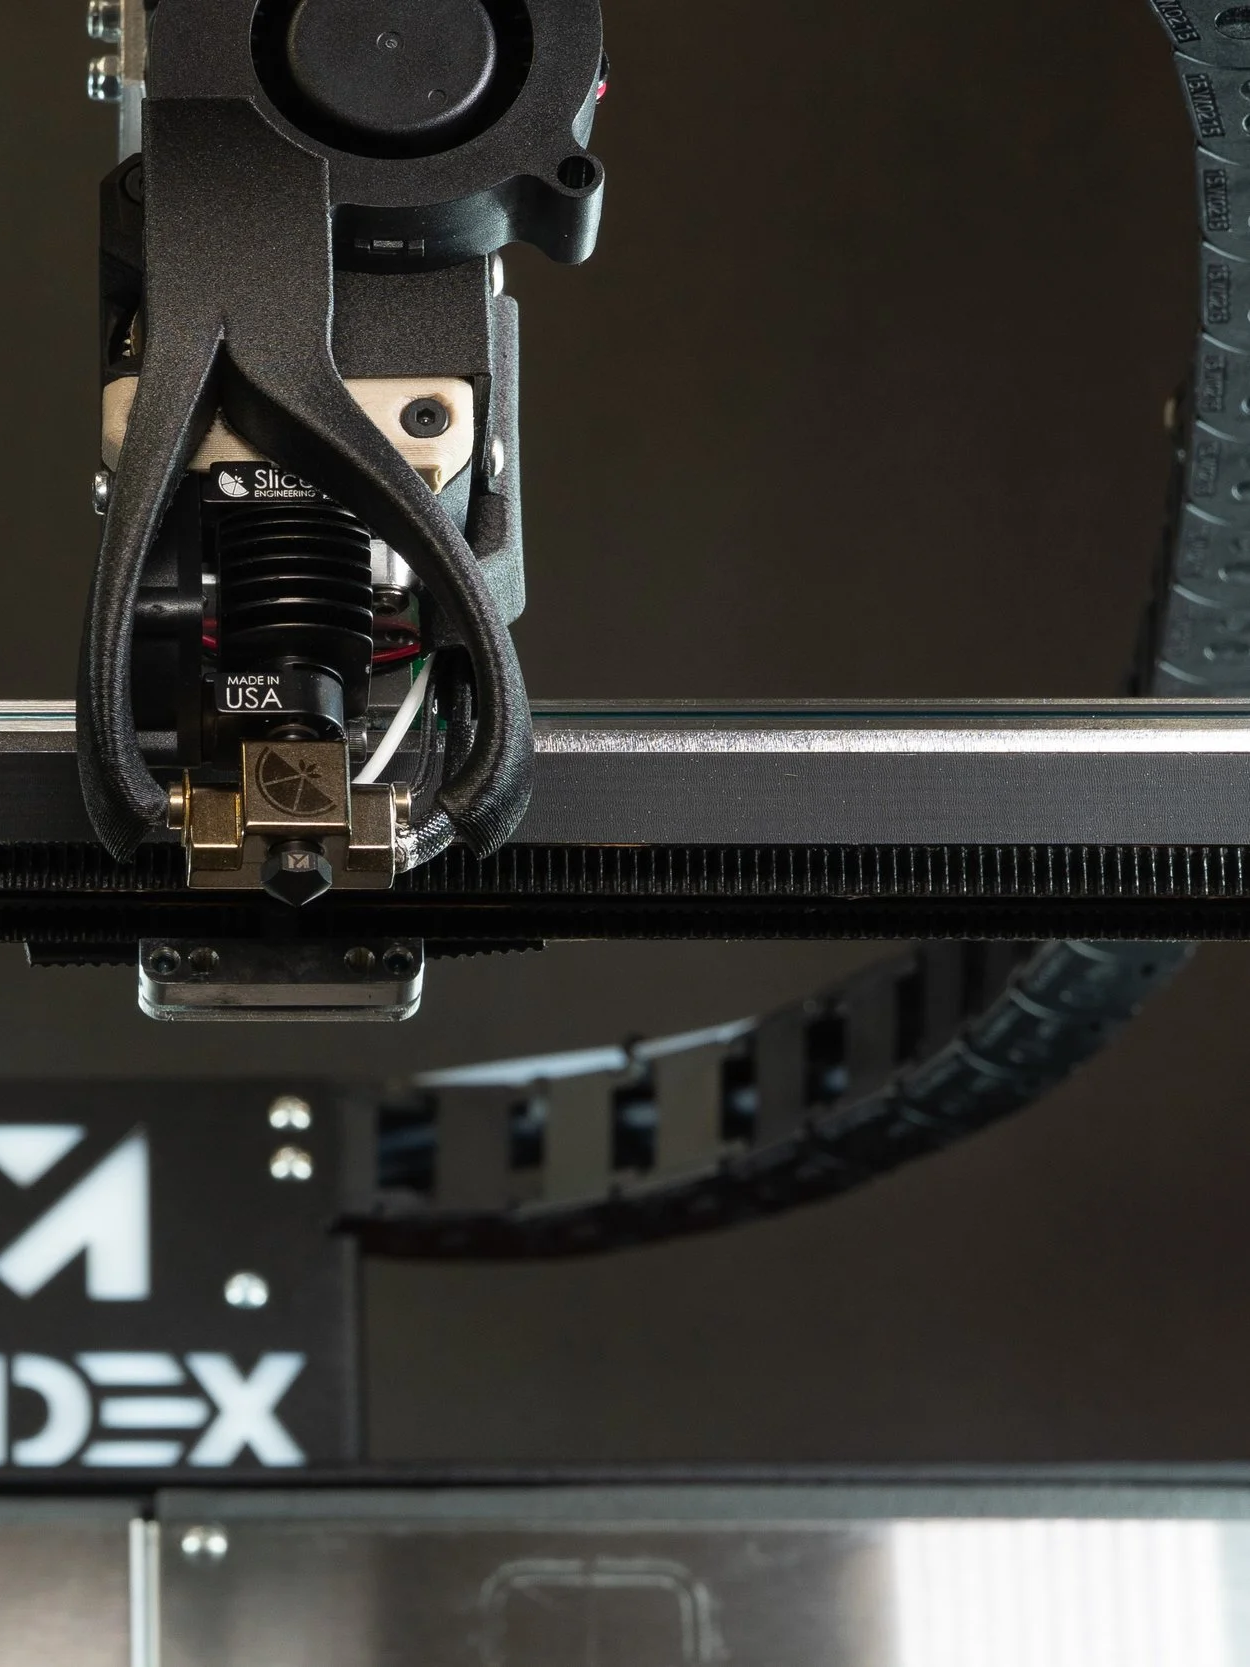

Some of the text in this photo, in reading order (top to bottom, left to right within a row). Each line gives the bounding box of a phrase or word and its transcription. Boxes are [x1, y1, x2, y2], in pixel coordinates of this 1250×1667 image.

[253, 489, 316, 498] ENGINEERING
[227, 675, 280, 686] MADE IN
[226, 687, 283, 709] USA
